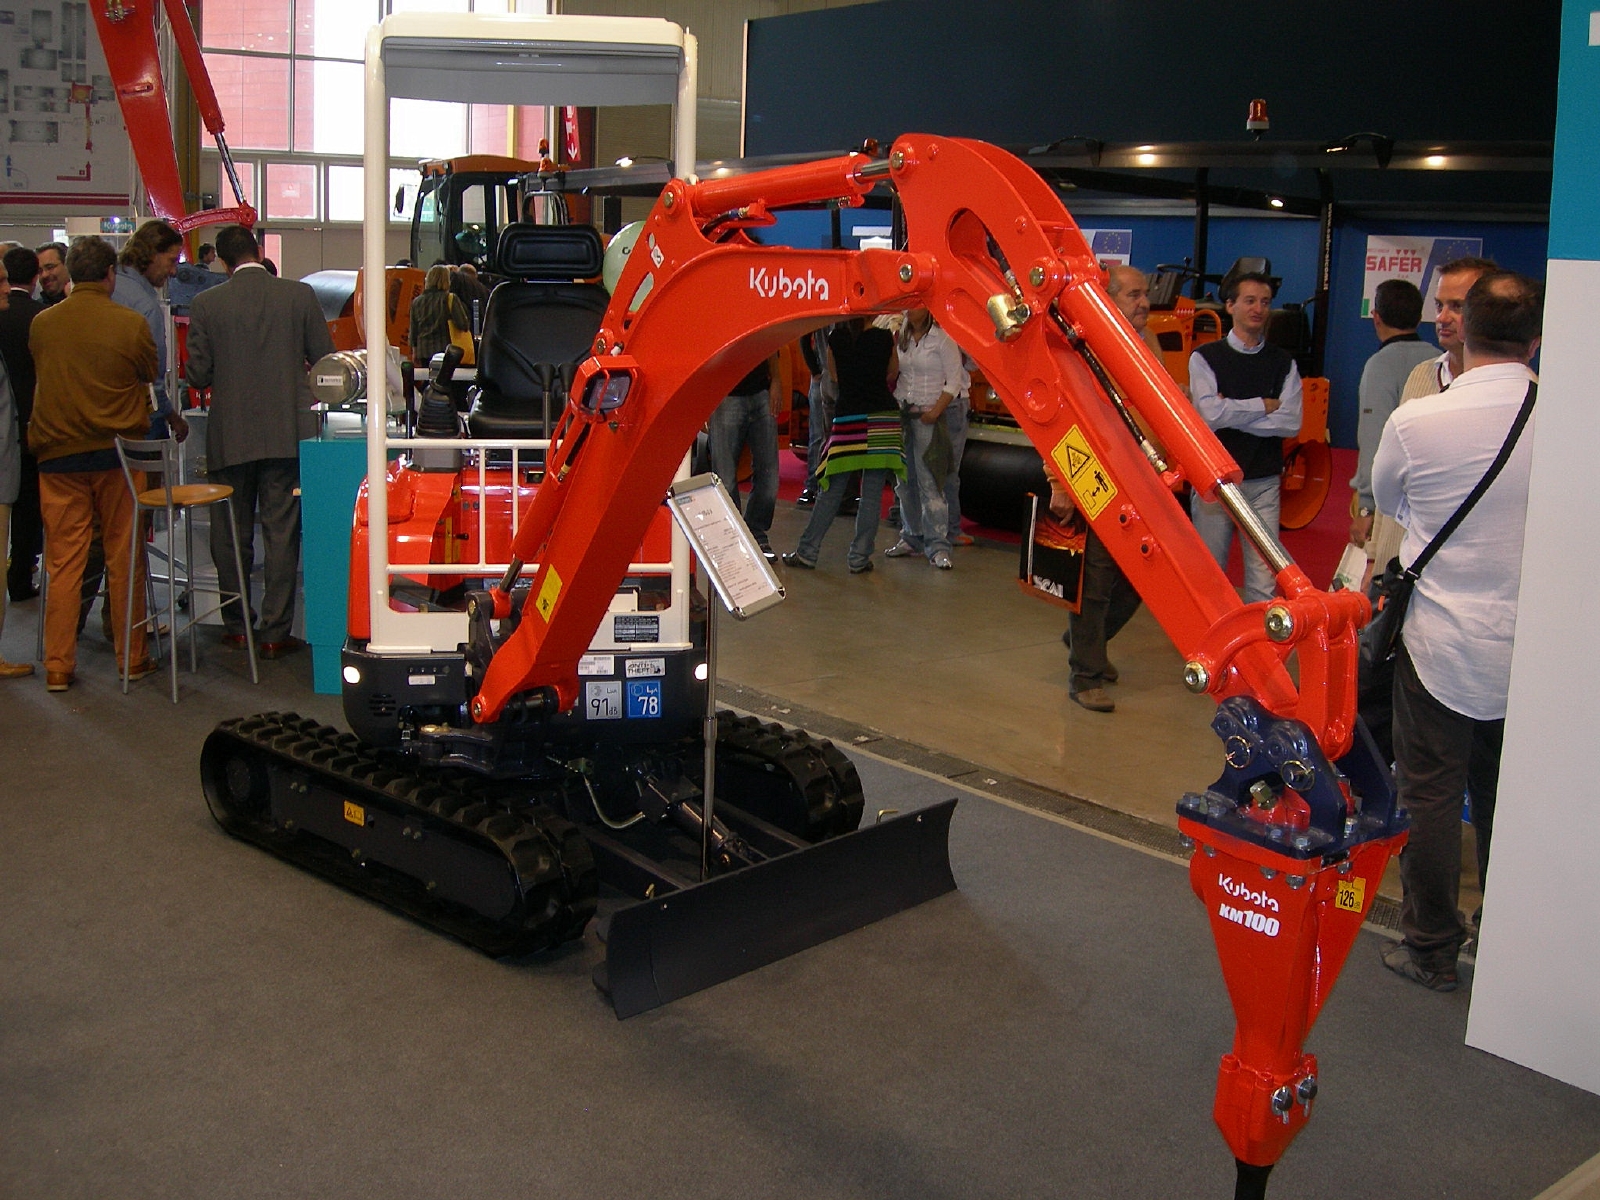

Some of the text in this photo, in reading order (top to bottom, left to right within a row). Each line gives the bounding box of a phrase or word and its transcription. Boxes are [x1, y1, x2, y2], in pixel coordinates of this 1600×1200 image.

[1366, 255, 1423, 273] SAFER
[749, 267, 829, 301] Kubota
[591, 698, 609, 716] 91
[637, 696, 659, 715] 78
[1218, 873, 1280, 912] Kubota
[1339, 889, 1355, 908] 126
[1219, 903, 1280, 937] KM100
